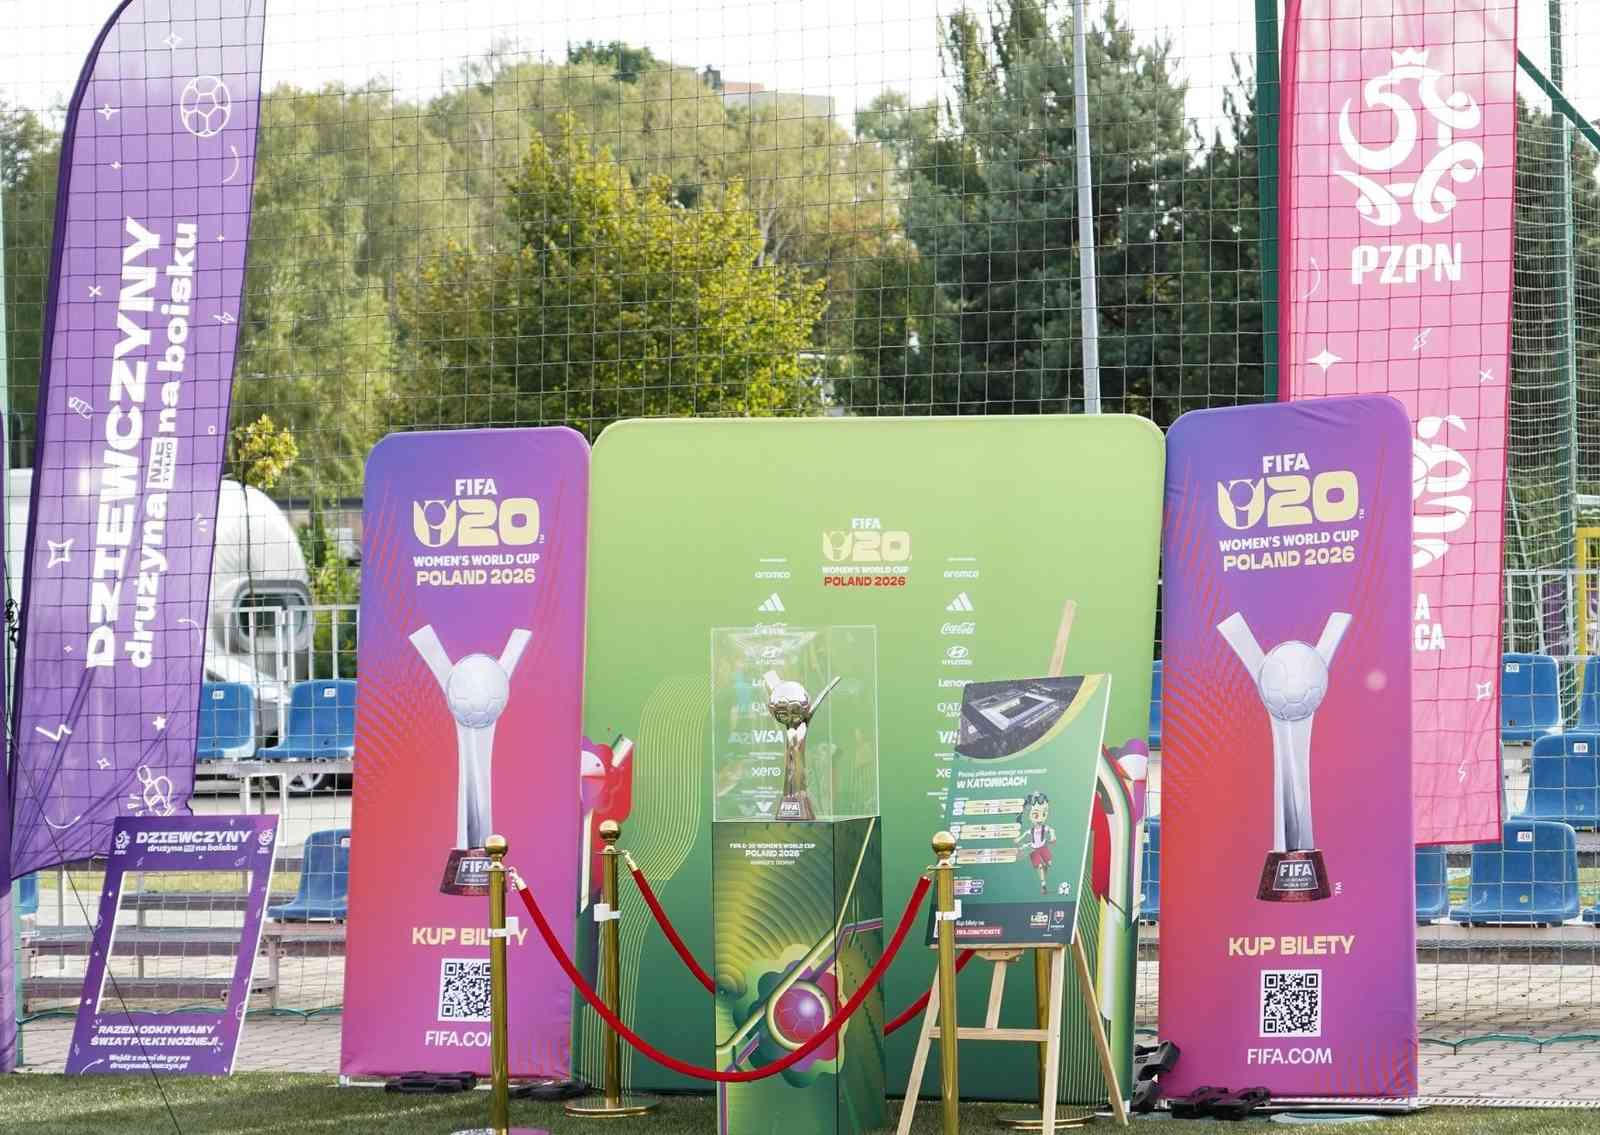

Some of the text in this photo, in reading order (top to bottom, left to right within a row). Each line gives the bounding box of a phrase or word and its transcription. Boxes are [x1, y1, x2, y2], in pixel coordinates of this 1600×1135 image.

[1351, 242, 1462, 285] PZPN
[157, 223, 198, 372] boisku
[158, 380, 180, 433] na
[86, 216, 161, 668] DZIEWCZYNY
[1262, 452, 1310, 474] FIFA
[455, 478, 498, 496] FIFA
[1217, 470, 1359, 530] U20
[413, 497, 540, 548] U20
[852, 517, 881, 529] FIFA
[822, 530, 910, 562] U20
[1219, 529, 1360, 553] WOMEN'S WORLD CUP
[413, 552, 540, 567] WOMEN'S WORLD CUP
[1223, 546, 1356, 571] POLAND 2026
[125, 488, 168, 668] drużyna
[416, 567, 537, 586] POLAND 2026
[863, 565, 892, 575] WORLD
[824, 576, 906, 587] POLAND 2026
[752, 729, 784, 744] VISA
[752, 765, 781, 777] xero
[136, 830, 252, 844] DZIEWCZYNY
[745, 850, 777, 858] POLAND
[1279, 863, 1313, 877] FIFA
[412, 927, 456, 945] KUP
[1229, 934, 1356, 957] KUP BILETY
[140, 1025, 215, 1034] ODKRYWAMY
[1247, 1047, 1333, 1065] FIFA.COM
